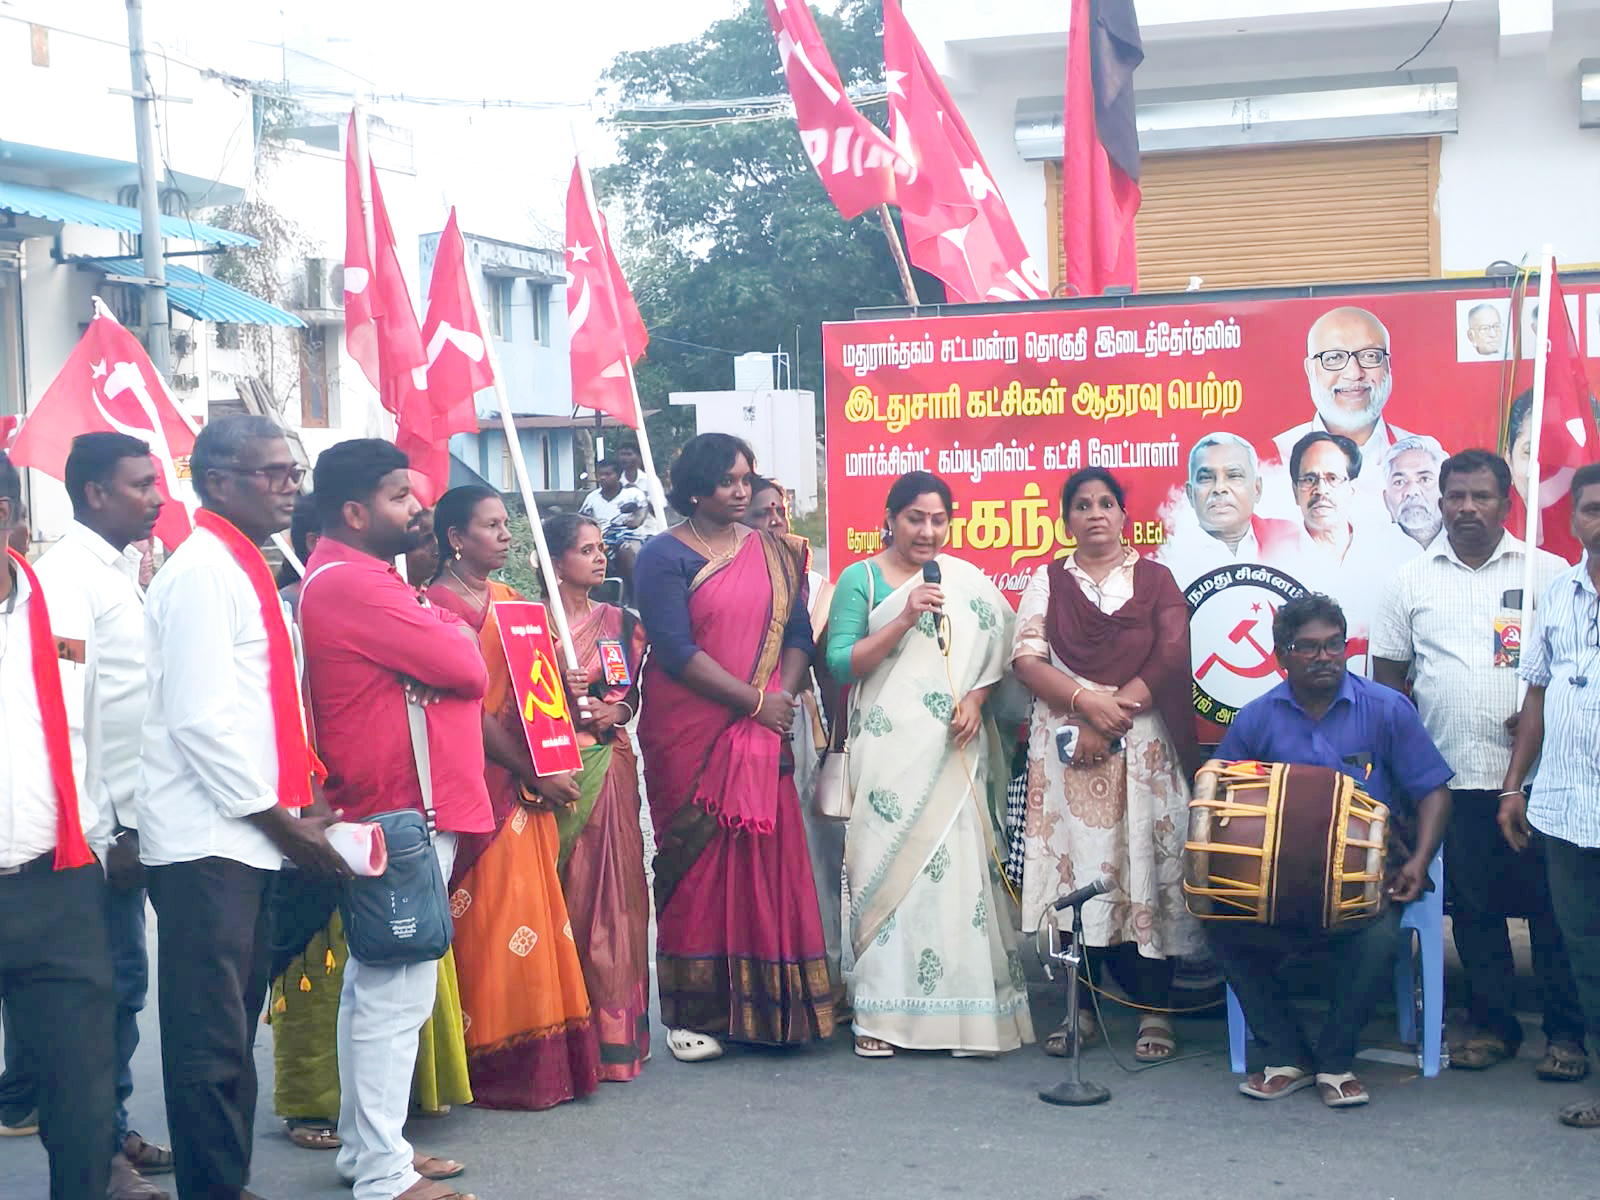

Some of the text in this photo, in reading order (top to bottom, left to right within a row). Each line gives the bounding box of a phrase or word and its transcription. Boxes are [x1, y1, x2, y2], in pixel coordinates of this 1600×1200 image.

[843, 316, 1241, 376] மதுராந்தகம் சட்டமன்ற தொகுதி இடைத்தேர்தலில்
[844, 371, 1242, 433] இடதுசாரி கட்சிகள் ஆதரவு பெற்ற
[938, 439, 1036, 483] கம்யூனிஸ்ட்
[1043, 440, 1081, 470] கட்சி
[1088, 433, 1179, 468] வேட்பாளர்
[1187, 571, 1233, 607] நமது
